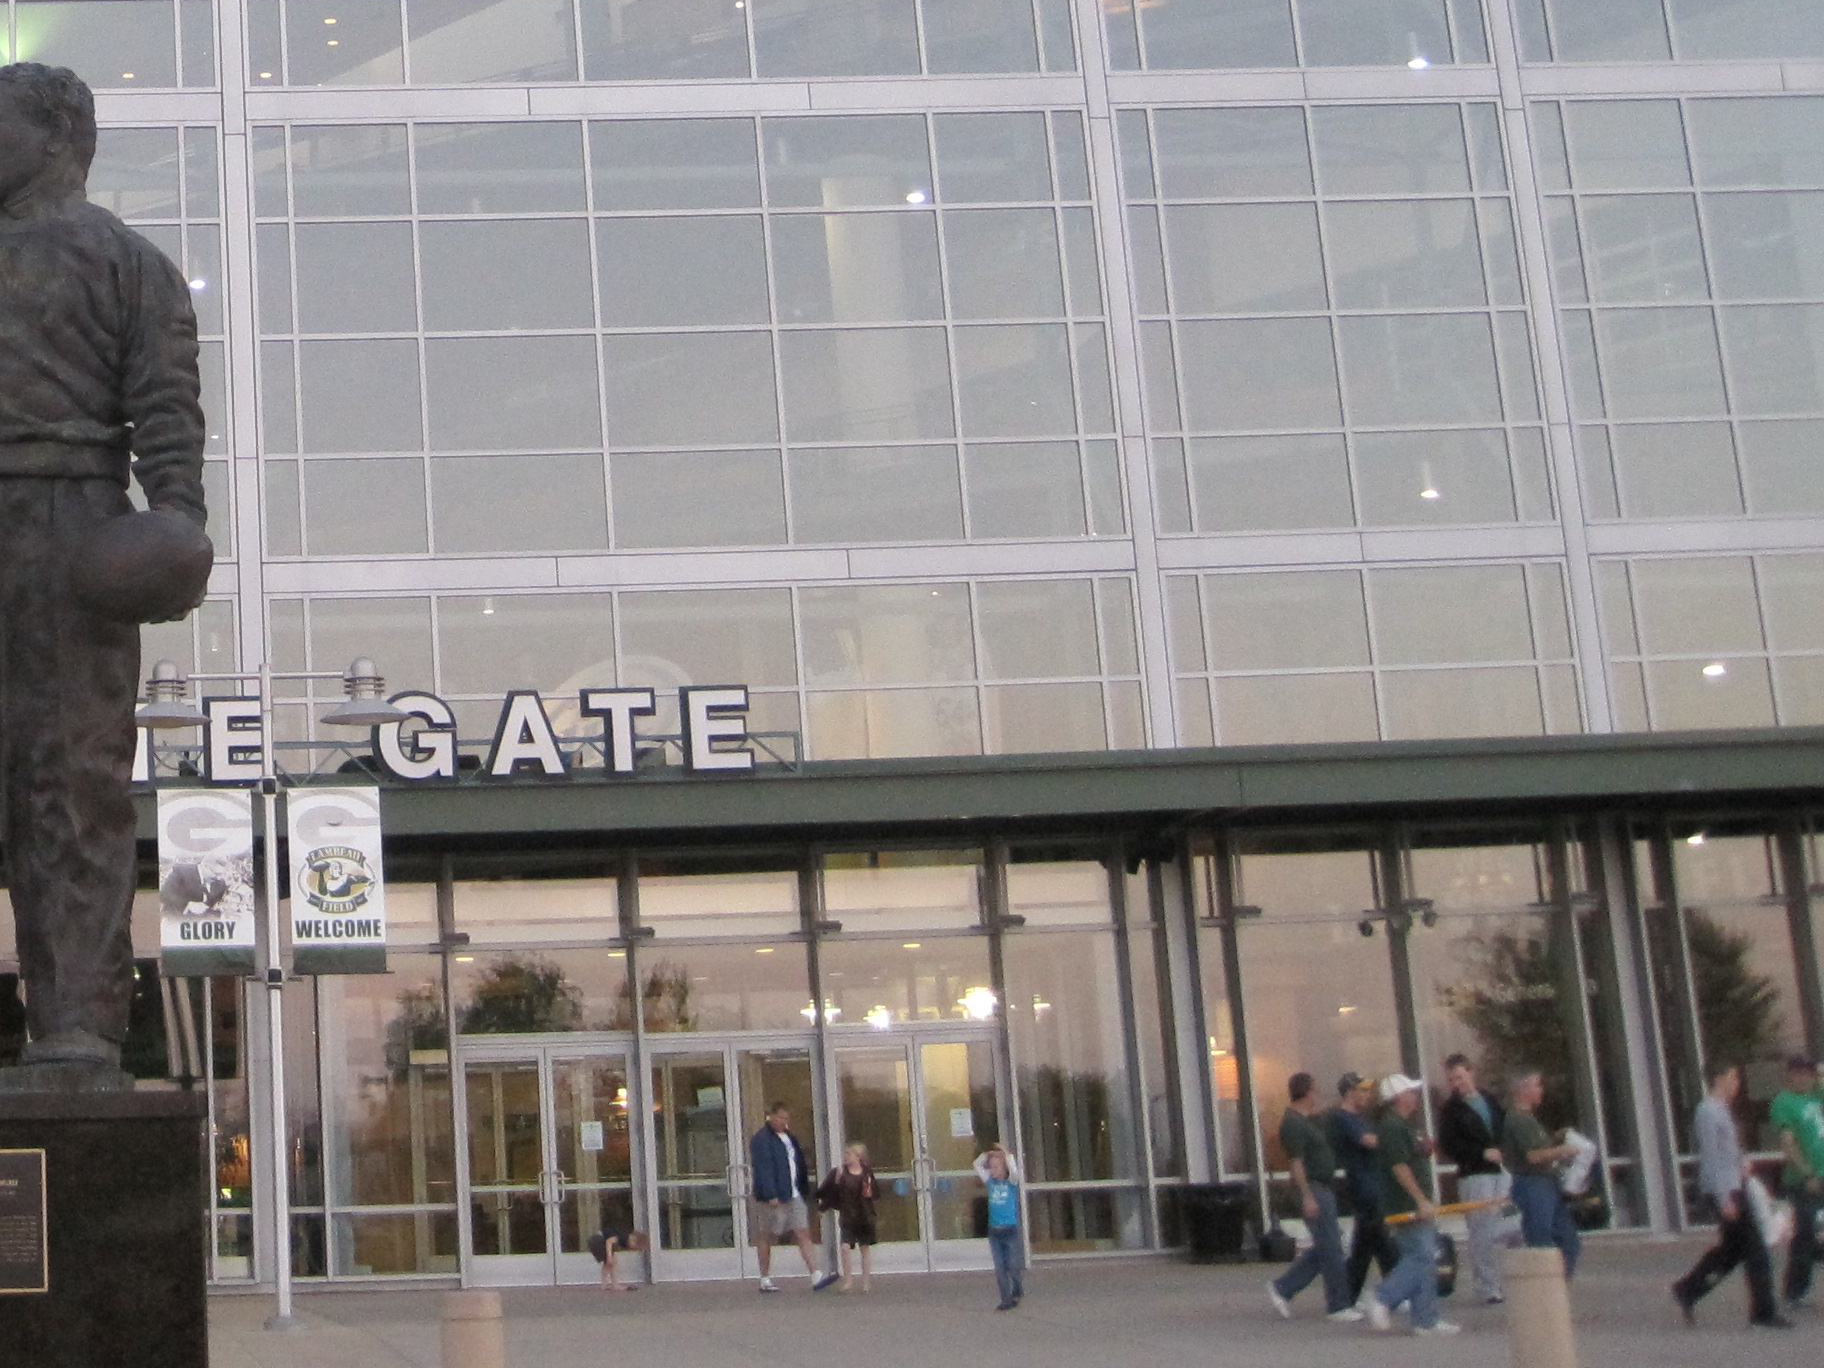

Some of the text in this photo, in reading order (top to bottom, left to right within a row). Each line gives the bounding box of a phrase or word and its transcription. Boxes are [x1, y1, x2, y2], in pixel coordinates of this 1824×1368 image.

[377, 685, 755, 782] GATE
[310, 846, 362, 862] LAMBEAU
[321, 900, 354, 913] FIELD
[180, 921, 236, 940] GLORY
[295, 919, 381, 939] WELCOME
